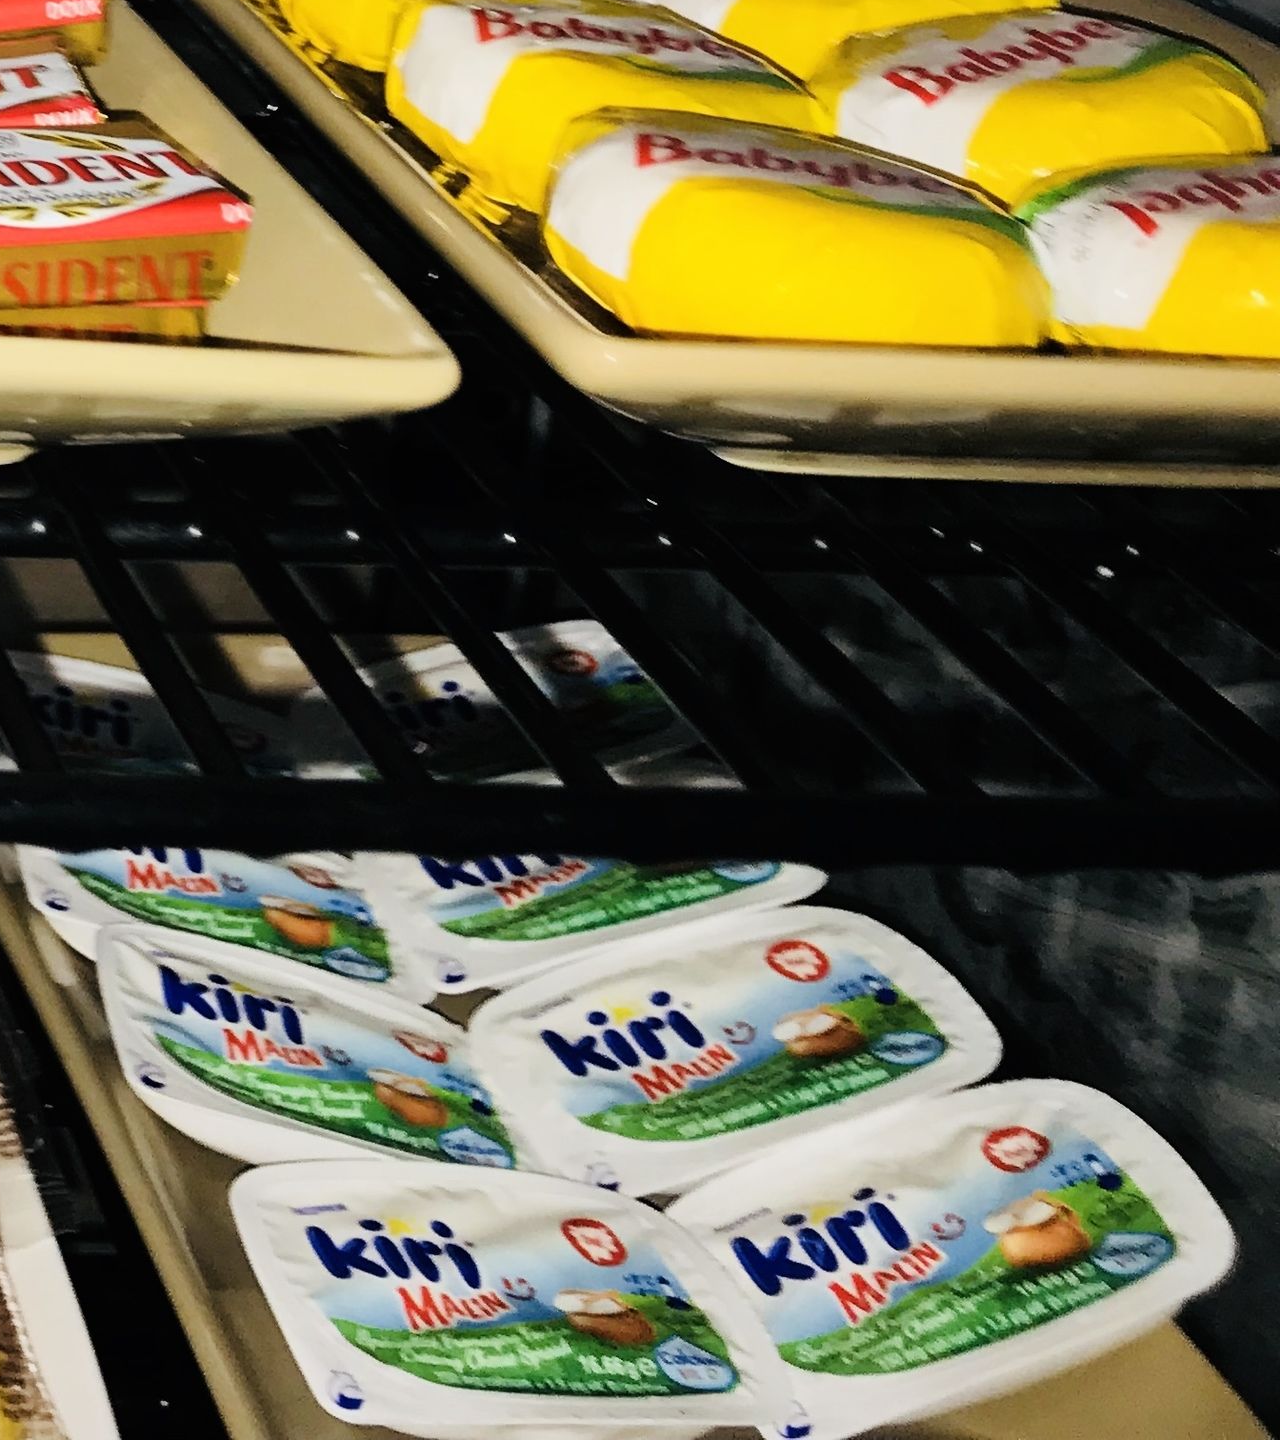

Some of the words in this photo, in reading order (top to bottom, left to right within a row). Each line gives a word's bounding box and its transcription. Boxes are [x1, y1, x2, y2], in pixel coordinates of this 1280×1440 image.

[468, 7, 740, 58] Babybe
[881, 18, 1118, 105] Babybe
[635, 133, 948, 194] Babybe
[158, 962, 306, 1046] kiri
[541, 989, 706, 1078] kiri
[304, 1218, 484, 1290] kiri
[730, 1186, 913, 1297] kiri
[393, 1283, 511, 1334] MALIN
